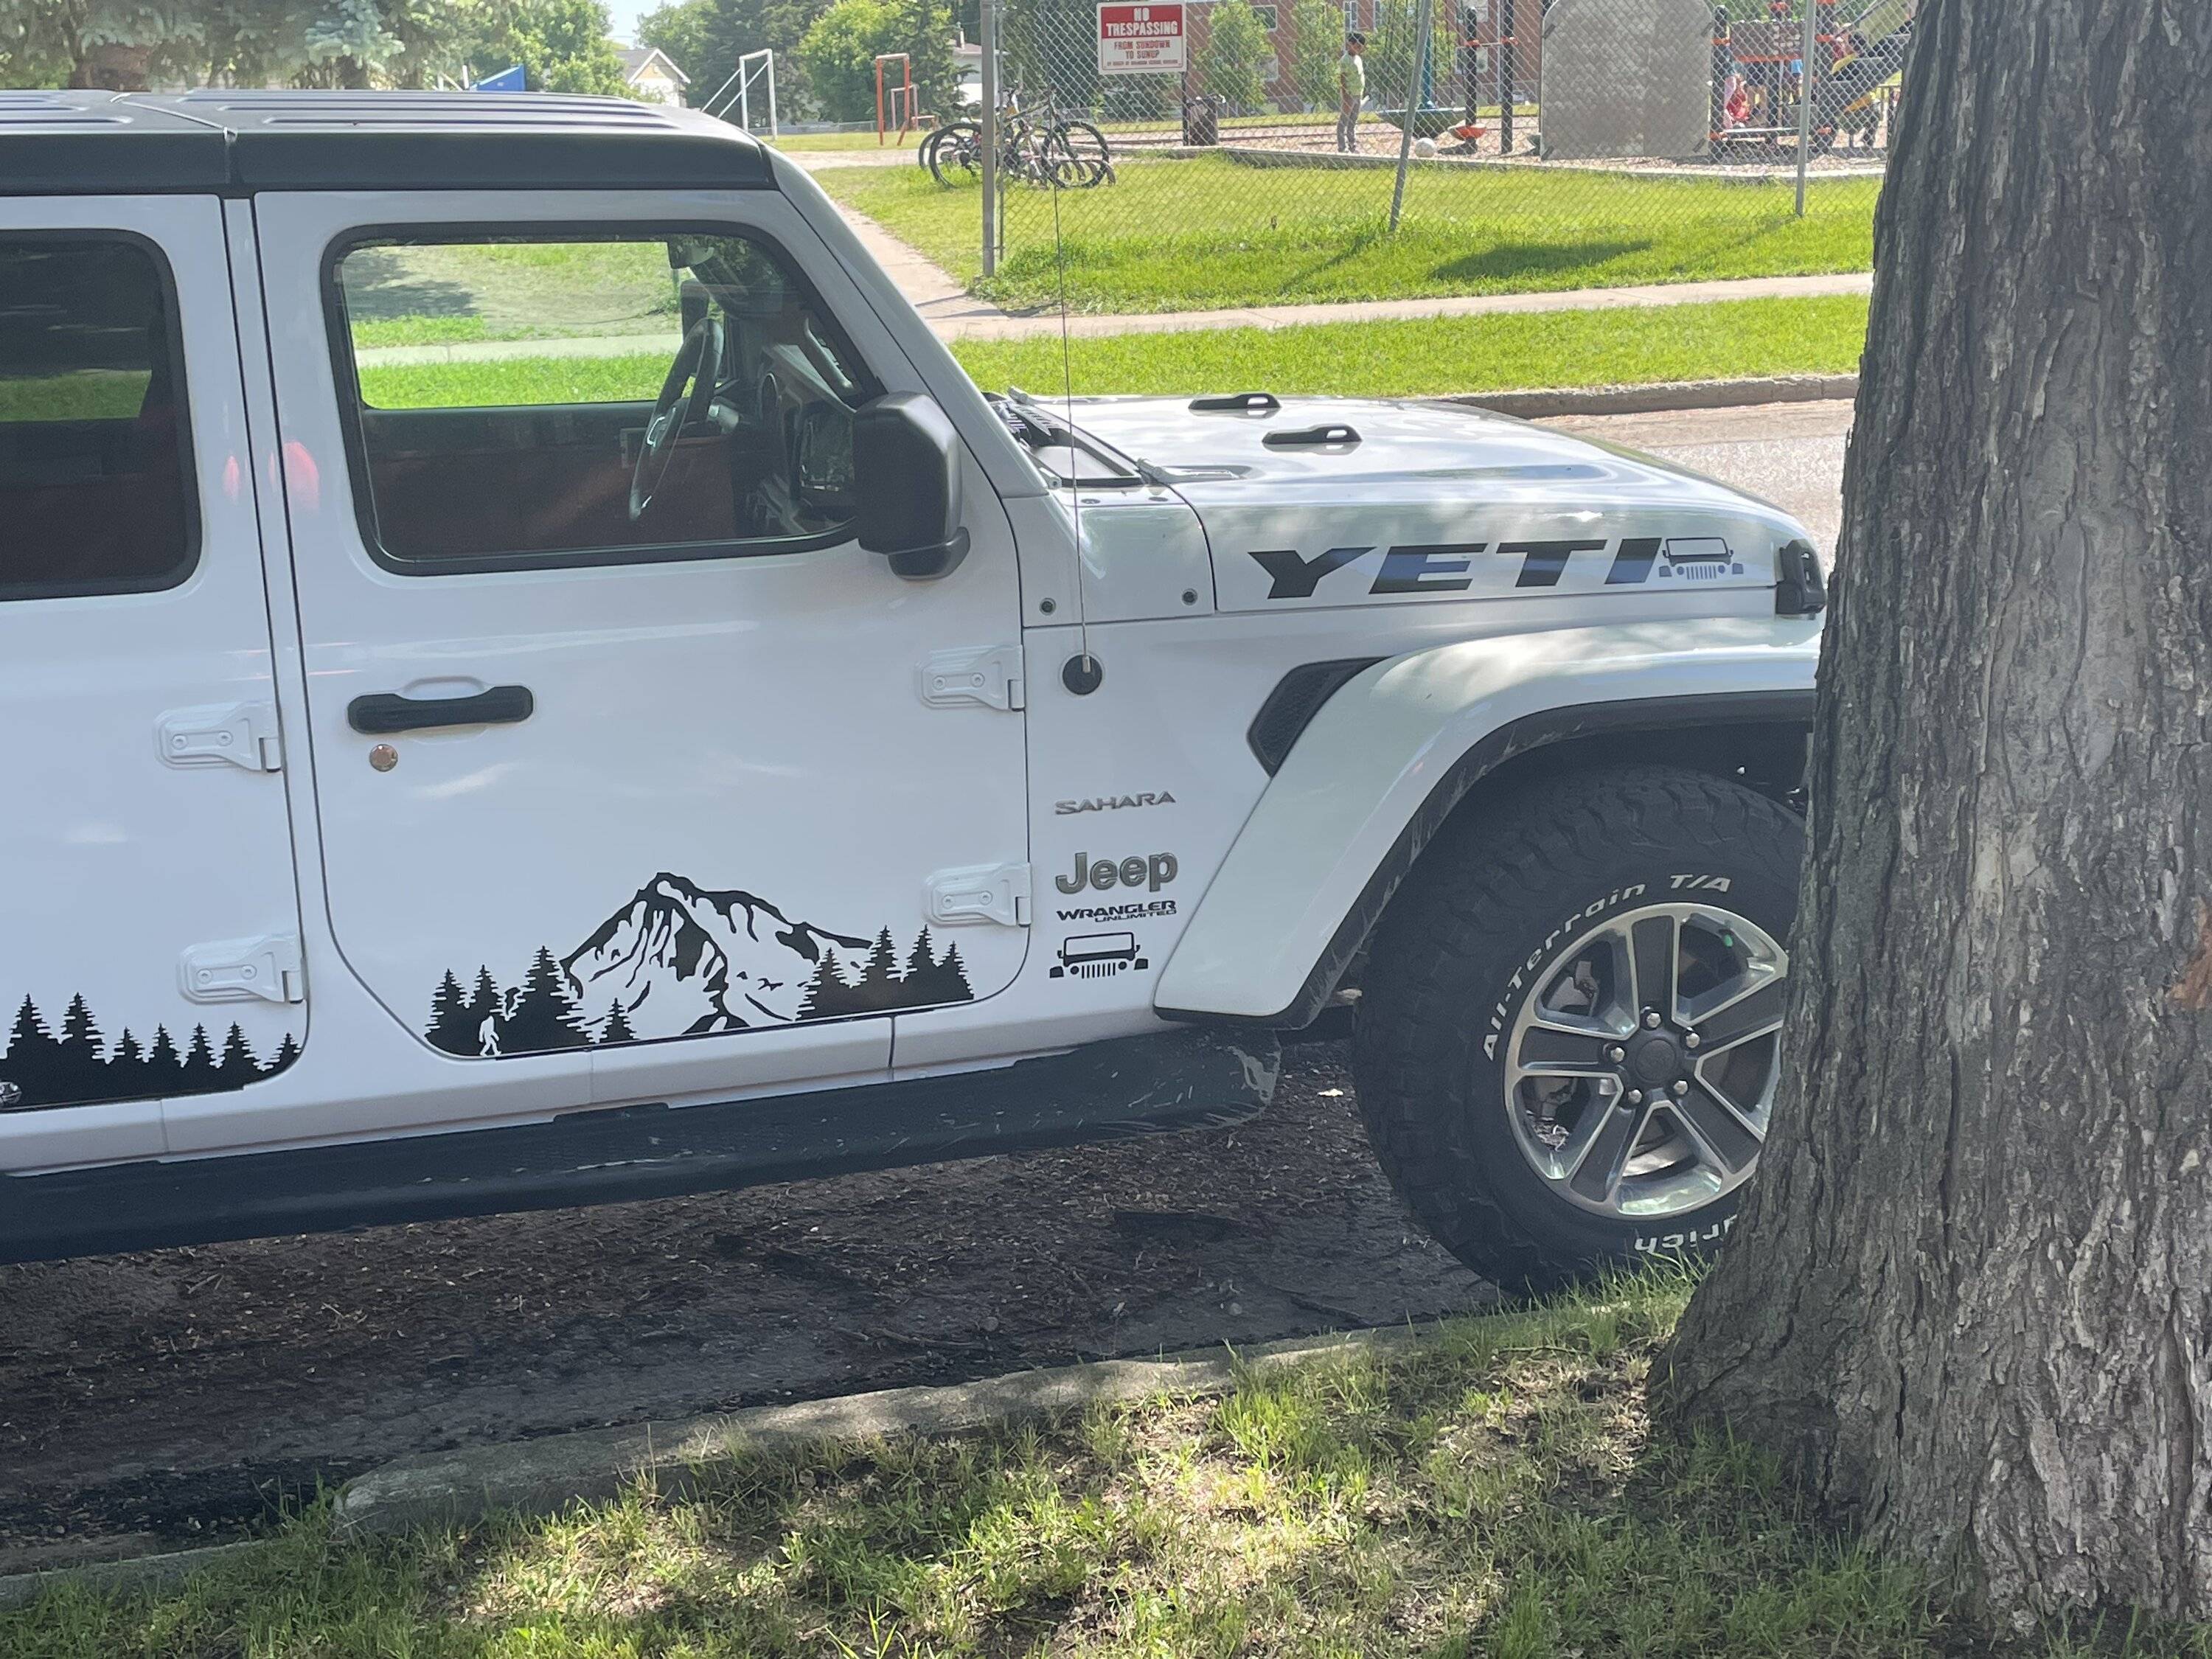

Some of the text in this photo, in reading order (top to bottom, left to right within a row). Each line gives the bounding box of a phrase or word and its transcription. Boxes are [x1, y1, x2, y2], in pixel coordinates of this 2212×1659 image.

[1133, 7, 1150, 21] NO
[1107, 21, 1178, 37] TRESPASSING
[1114, 40, 1170, 50] FROM SUNDOWN
[1125, 51, 1134, 60] TO
[1247, 537, 1663, 600] YETI
[1055, 790, 1177, 815] SAHARA
[1055, 852, 1178, 894] Jeep
[1056, 900, 1177, 922] WRANGLER
[1095, 909, 1178, 923] UNLIMITED
[1483, 873, 1732, 1062] All-Terrain T/A
